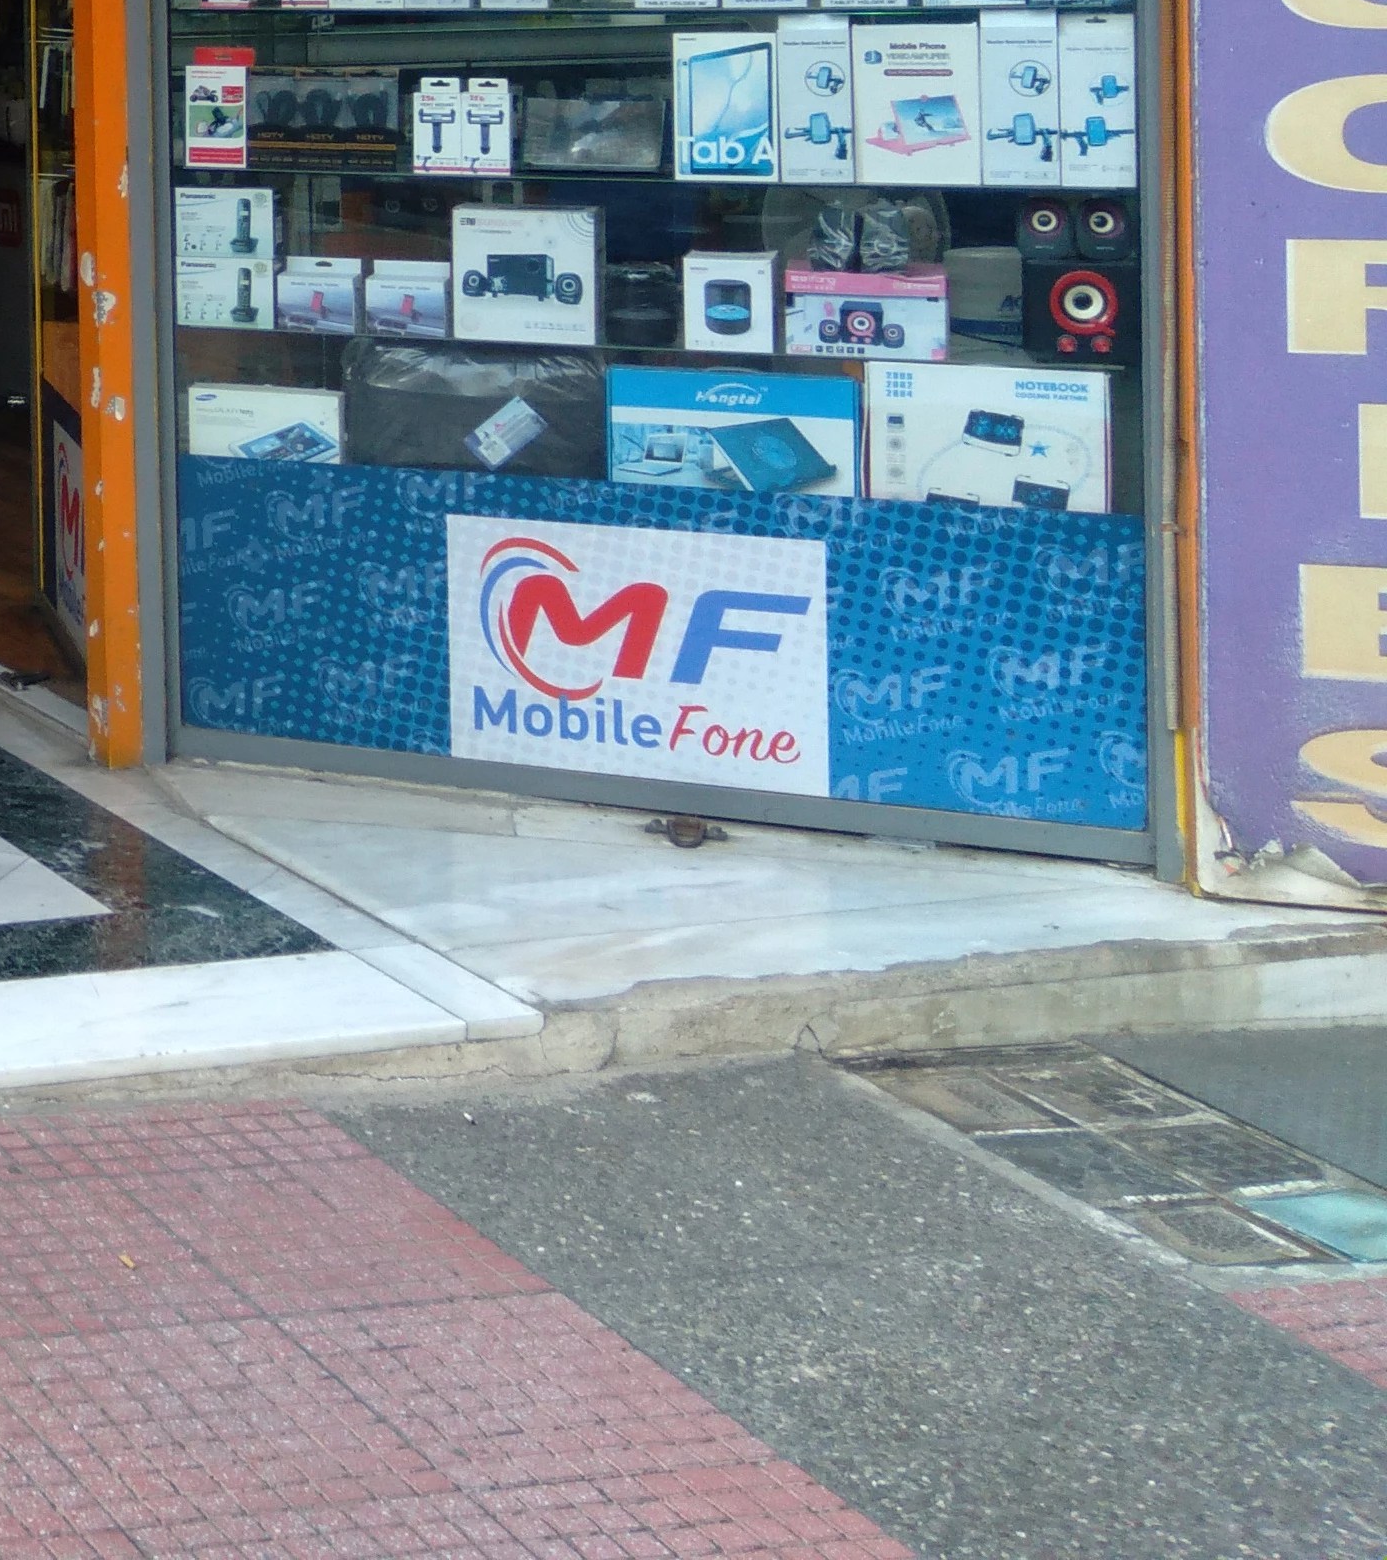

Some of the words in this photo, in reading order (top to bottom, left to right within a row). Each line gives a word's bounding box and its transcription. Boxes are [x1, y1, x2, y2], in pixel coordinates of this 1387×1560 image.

[677, 136, 746, 165] Tab
[180, 192, 216, 200] Panasonic
[181, 261, 217, 269] Panasonic
[1014, 380, 1089, 393] NOTEBOOK
[489, 540, 812, 702] MF
